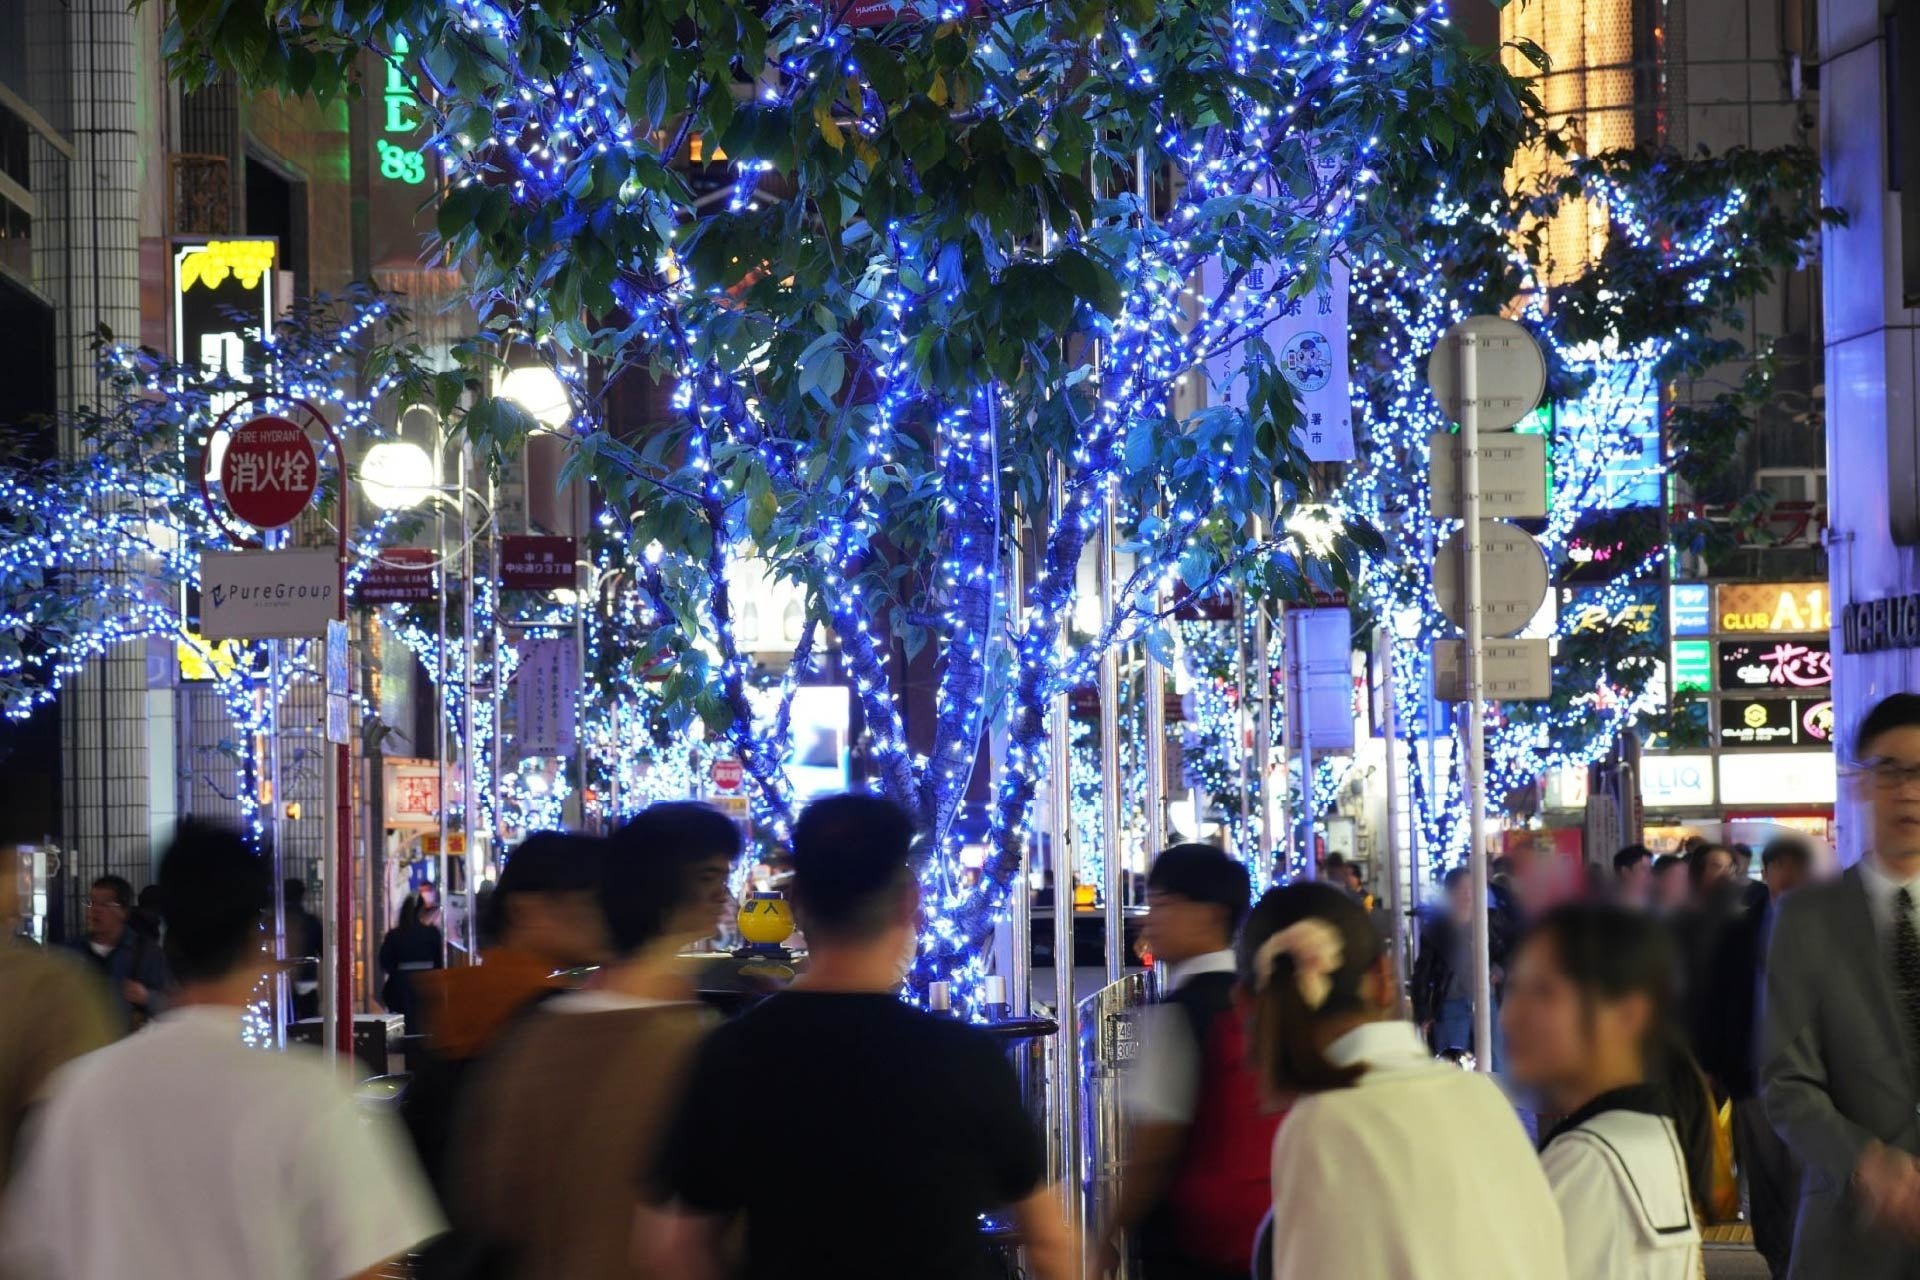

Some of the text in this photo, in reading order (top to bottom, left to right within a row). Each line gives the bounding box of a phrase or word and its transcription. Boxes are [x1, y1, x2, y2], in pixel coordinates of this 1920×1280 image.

[377, 139, 426, 184] '83
[237, 430, 300, 443] FIRE HYDRANT
[230, 449, 310, 493] 消火栓
[230, 583, 331, 601] PureGroup
[1723, 612, 1769, 630] CLUB
[1770, 588, 1822, 630] A-1
